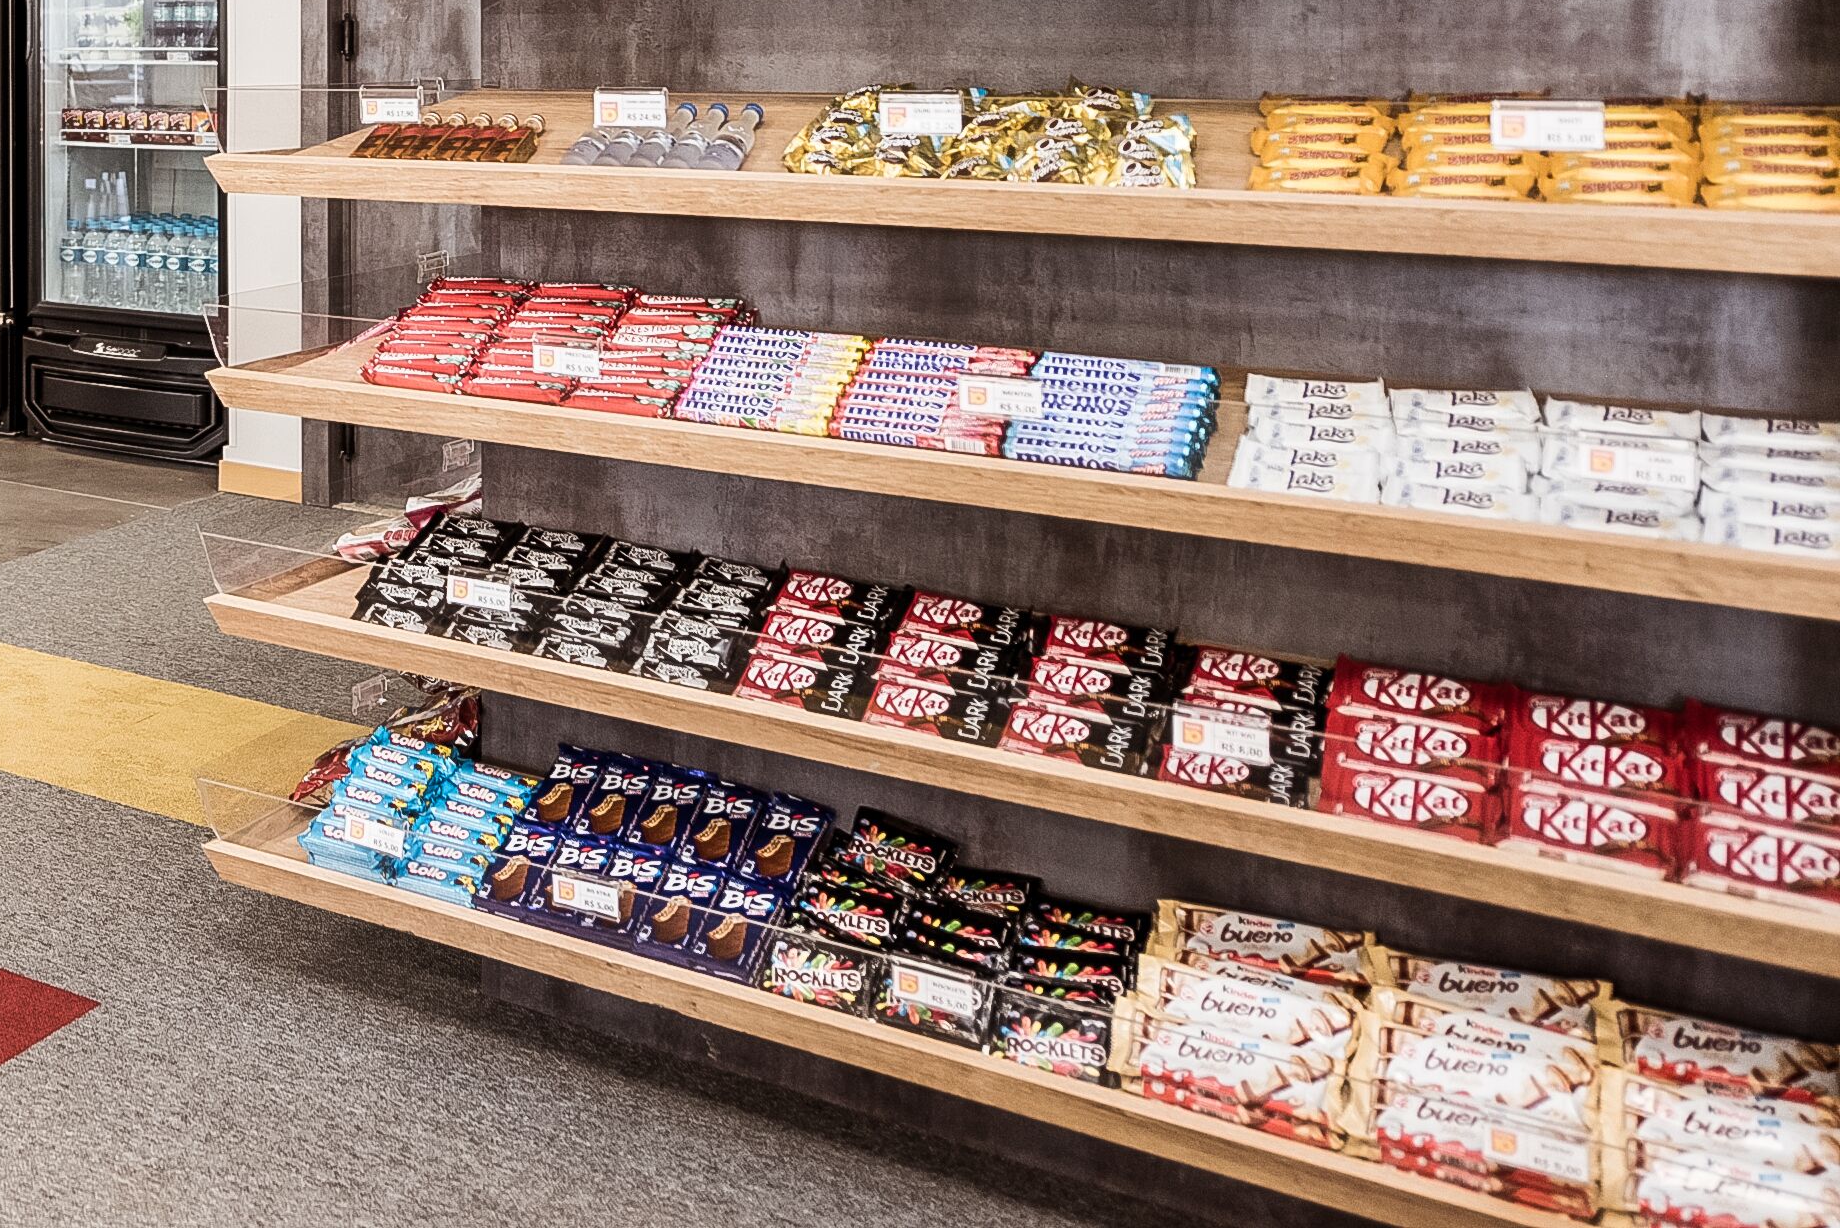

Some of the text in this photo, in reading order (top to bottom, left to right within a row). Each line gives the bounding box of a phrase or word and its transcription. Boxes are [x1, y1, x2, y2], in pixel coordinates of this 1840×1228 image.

[722, 335, 804, 351] mentos
[1044, 365, 1141, 382] mentos
[1051, 356, 1127, 370] mentos
[690, 390, 774, 408] mentos
[1303, 382, 1348, 400] Laka
[848, 406, 940, 423] mentos
[843, 428, 914, 446] mentos
[1310, 426, 1356, 443] Laka
[1453, 440, 1502, 455] Laka
[1015, 453, 1120, 471] mentos
[1436, 461, 1485, 479] Laka
[1287, 470, 1336, 492] Laka
[1443, 488, 1496, 509] Laka
[1606, 509, 1659, 528] Laka
[1774, 528, 1833, 549] Laka
[786, 576, 852, 602] KitKat
[857, 584, 889, 621] DARK
[913, 599, 983, 624] KitKat
[990, 606, 1020, 645] DARK
[747, 661, 816, 691] KitKat
[1201, 653, 1280, 681] KitKat
[1035, 665, 1111, 694] KitKat
[1363, 672, 1470, 710] KitKat
[821, 672, 854, 712] DARK
[876, 687, 949, 717] KitKat
[1123, 676, 1152, 717] DARK
[957, 696, 989, 740] DARK
[390, 732, 425, 750] Lollo
[1286, 712, 1315, 758] DARK
[1356, 722, 1468, 765] KitKat
[371, 745, 407, 764] Lollo
[346, 786, 382, 804] Lollo
[459, 782, 496, 803] Lollo
[1354, 775, 1469, 822] KitKat
[446, 800, 485, 818] Lollo
[429, 820, 469, 840] Lollo
[1523, 801, 1646, 846] KitKat
[848, 838, 936, 874] ROCKLETS
[1707, 834, 1839, 883] KitKat
[407, 862, 447, 880] Lollo
[1220, 923, 1293, 944] bueno
[774, 966, 862, 992] ROCKLETS
[1438, 971, 1519, 994] bueno
[1201, 991, 1277, 1020] bueno
[1006, 1036, 1107, 1066] ROCKLETS
[1178, 1037, 1255, 1065] bueno
[1673, 1029, 1762, 1055] bueno
